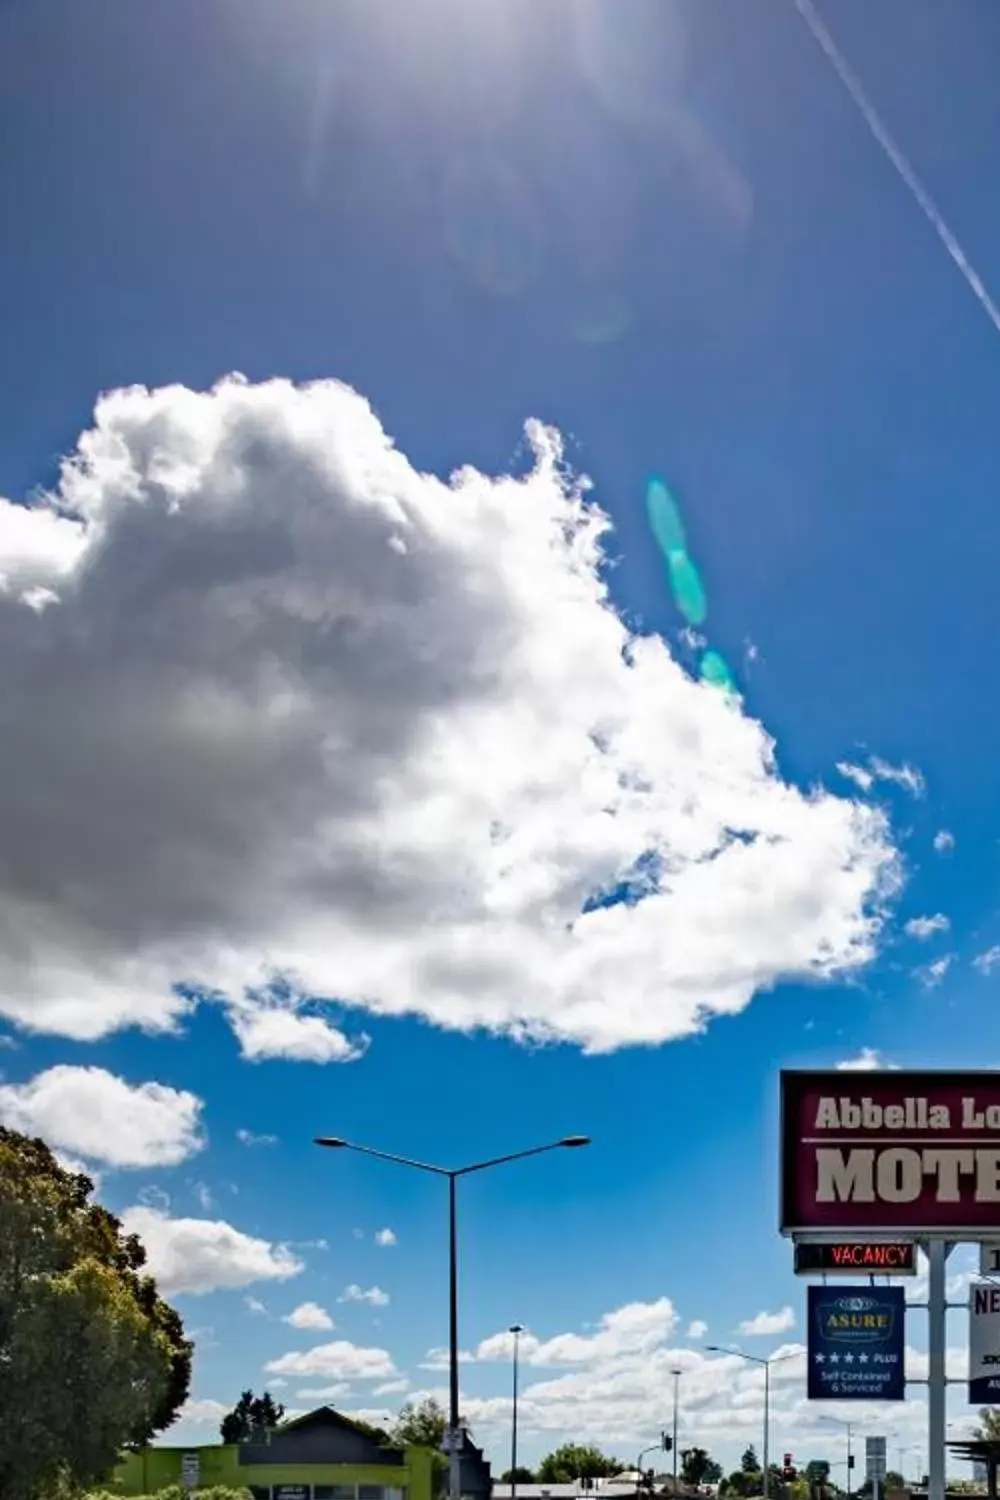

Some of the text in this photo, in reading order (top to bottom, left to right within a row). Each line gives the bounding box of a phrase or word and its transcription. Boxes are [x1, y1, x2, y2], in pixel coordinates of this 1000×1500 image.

[814, 1096, 951, 1129] Abbella
[831, 1246, 908, 1265] VACANCY
[827, 1313, 888, 1328] ASURE
